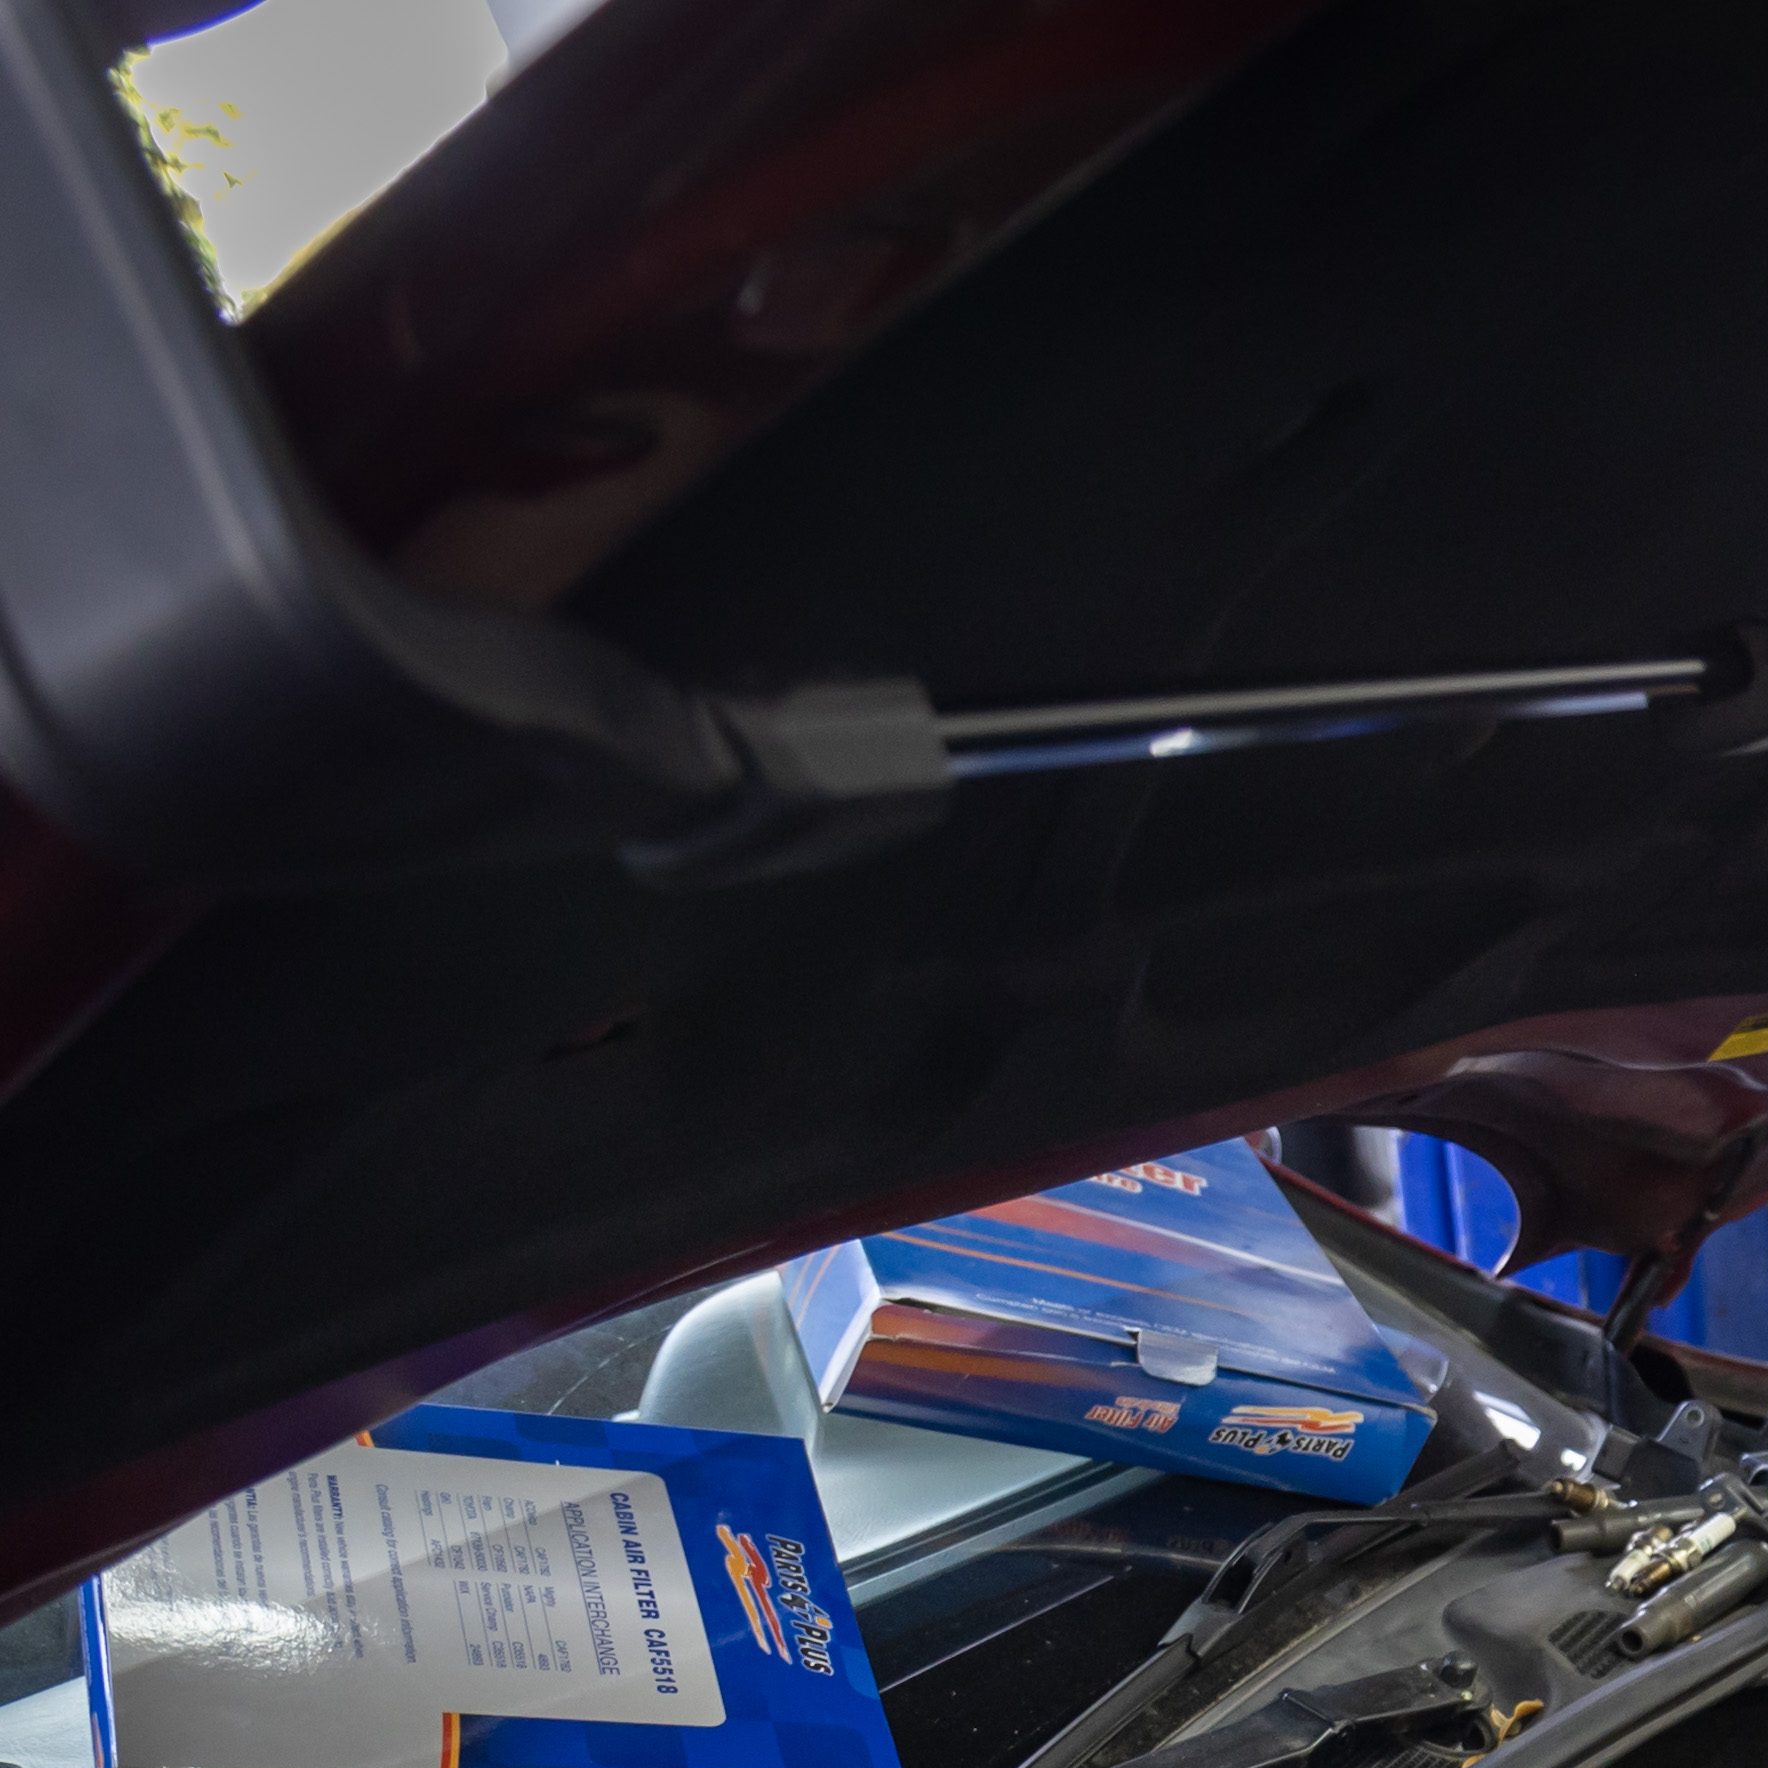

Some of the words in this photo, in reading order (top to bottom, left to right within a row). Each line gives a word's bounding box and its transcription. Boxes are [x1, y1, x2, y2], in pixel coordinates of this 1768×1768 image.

[1084, 1404, 1142, 1429] Filter
[1144, 1414, 1179, 1433] Air
[1208, 1427, 1260, 1448] PLUS
[1294, 1437, 1354, 1462] PARTS
[325, 1474, 343, 1520] WARRANTY:
[374, 1483, 391, 1510] Consult
[379, 1511, 396, 1537] catalog
[608, 1491, 638, 1535] CABIN
[385, 1538, 399, 1549] for
[621, 1538, 646, 1564] AIR
[561, 1501, 598, 1577] APPLICATION
[581, 1580, 620, 1675] INTERCHANGE
[628, 1568, 660, 1619] FILTER
[765, 1533, 811, 1595] PARTS
[791, 1620, 834, 1676] PLUS
[643, 1628, 678, 1694] CAF5518
